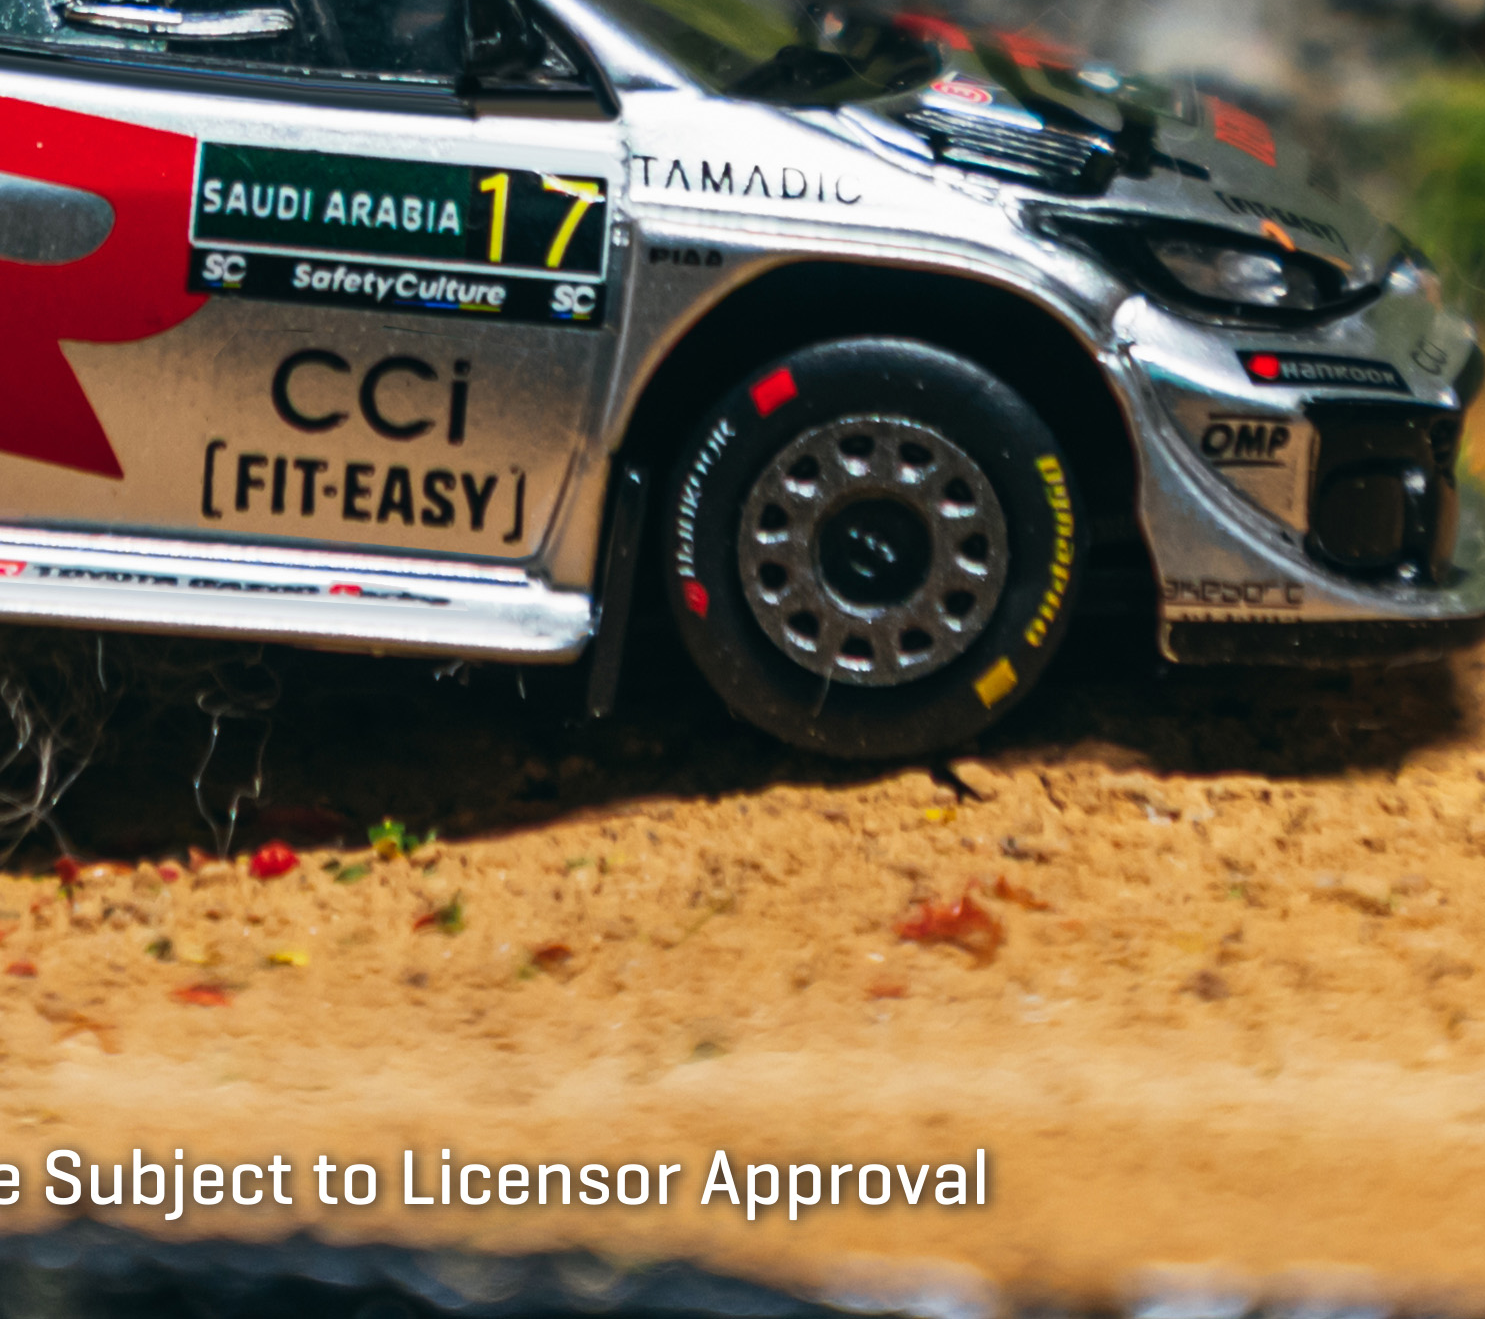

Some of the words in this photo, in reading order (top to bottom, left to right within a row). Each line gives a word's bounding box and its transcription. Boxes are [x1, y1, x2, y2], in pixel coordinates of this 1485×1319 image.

[202, 178, 313, 222] SAUDI
[322, 188, 463, 237] ARABIA
[631, 154, 863, 205] TAMADIC
[478, 171, 605, 269] 17
[201, 252, 248, 284] SC
[291, 262, 507, 308] SafetyCulture
[550, 284, 597, 315] SC
[1200, 423, 1290, 458] OMP
